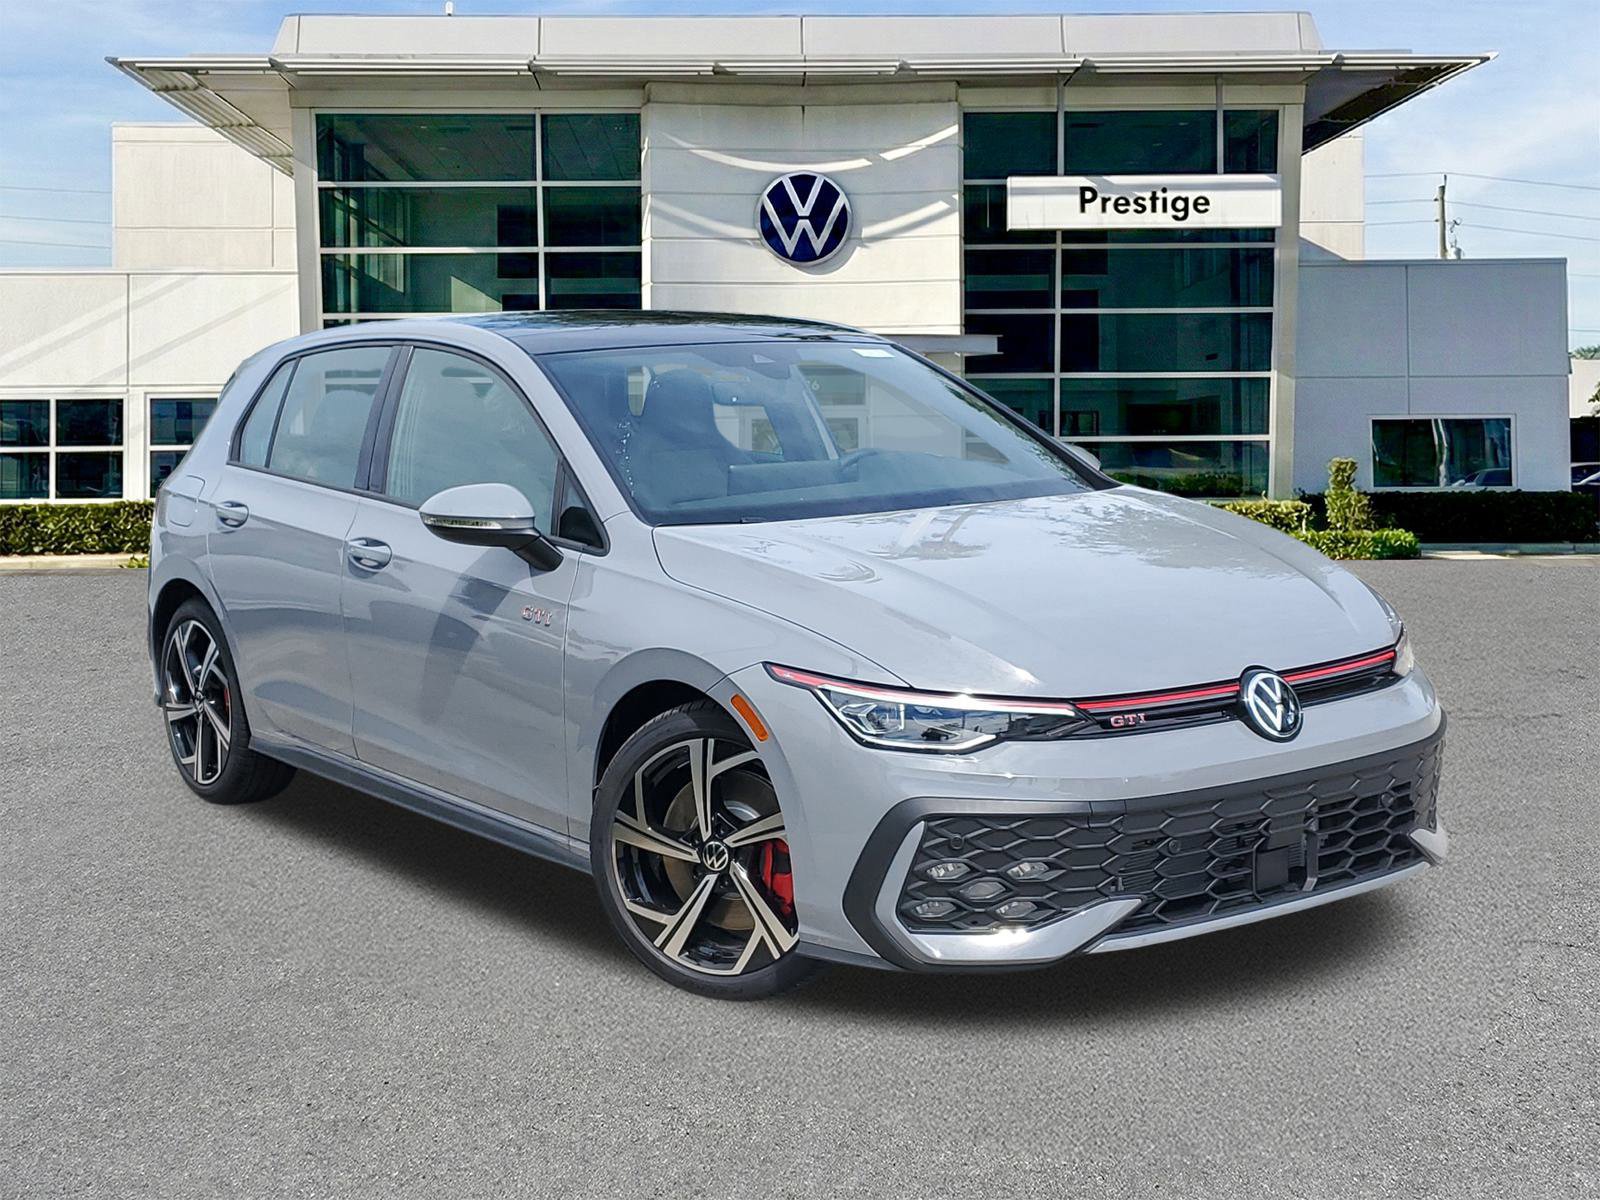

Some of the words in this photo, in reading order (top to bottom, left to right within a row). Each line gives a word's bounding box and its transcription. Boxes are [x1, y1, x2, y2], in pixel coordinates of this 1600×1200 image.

[757, 170, 850, 264] VW
[1079, 186, 1211, 222] Prestige
[521, 606, 552, 627] GTI
[1110, 712, 1147, 728] GTI
